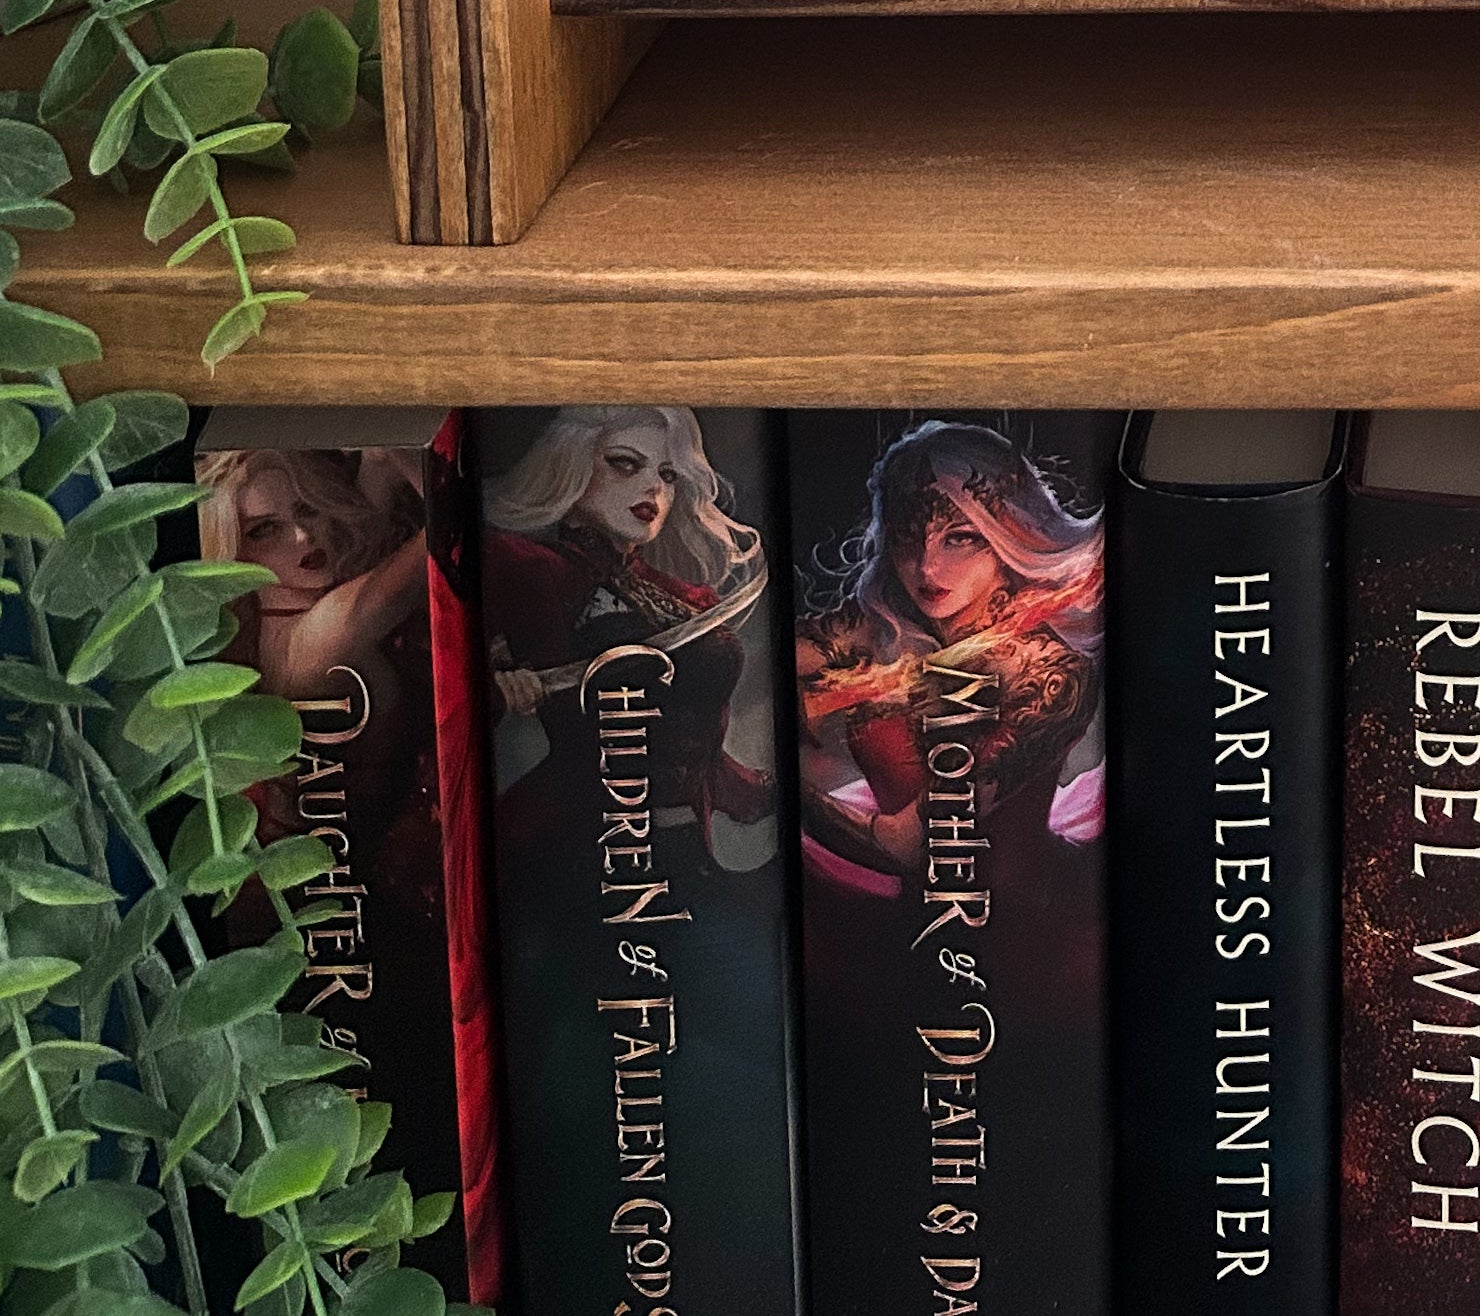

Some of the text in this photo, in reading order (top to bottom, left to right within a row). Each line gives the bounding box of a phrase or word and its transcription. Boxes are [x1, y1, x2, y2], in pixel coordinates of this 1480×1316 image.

[579, 644, 694, 924] CHILDREN
[911, 660, 1000, 949] MOTHER
[618, 940, 667, 982] of
[938, 946, 986, 991] of
[1213, 571, 1271, 1280] HEARTLESS HUNTER
[597, 993, 679, 1184] FALLEN
[915, 1002, 996, 1187] DEATH
[920, 1204, 979, 1235] &
